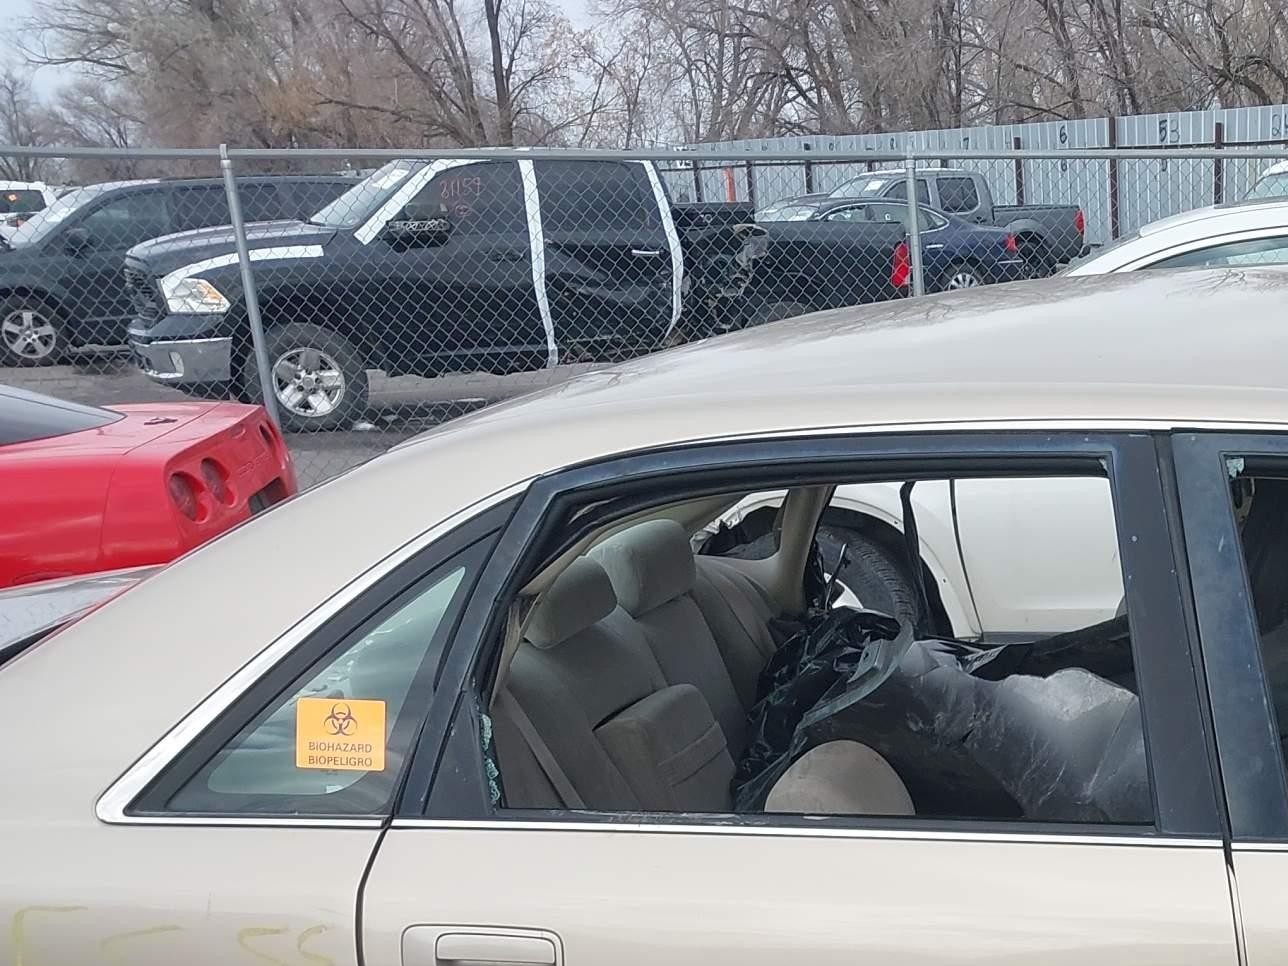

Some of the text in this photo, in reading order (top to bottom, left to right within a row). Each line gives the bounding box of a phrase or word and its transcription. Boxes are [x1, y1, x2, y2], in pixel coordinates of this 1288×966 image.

[1059, 124, 1069, 145] 6
[962, 136, 970, 151] 7
[308, 740, 373, 754] BIOHAZARD
[308, 754, 373, 768] BIOPELIGRO
